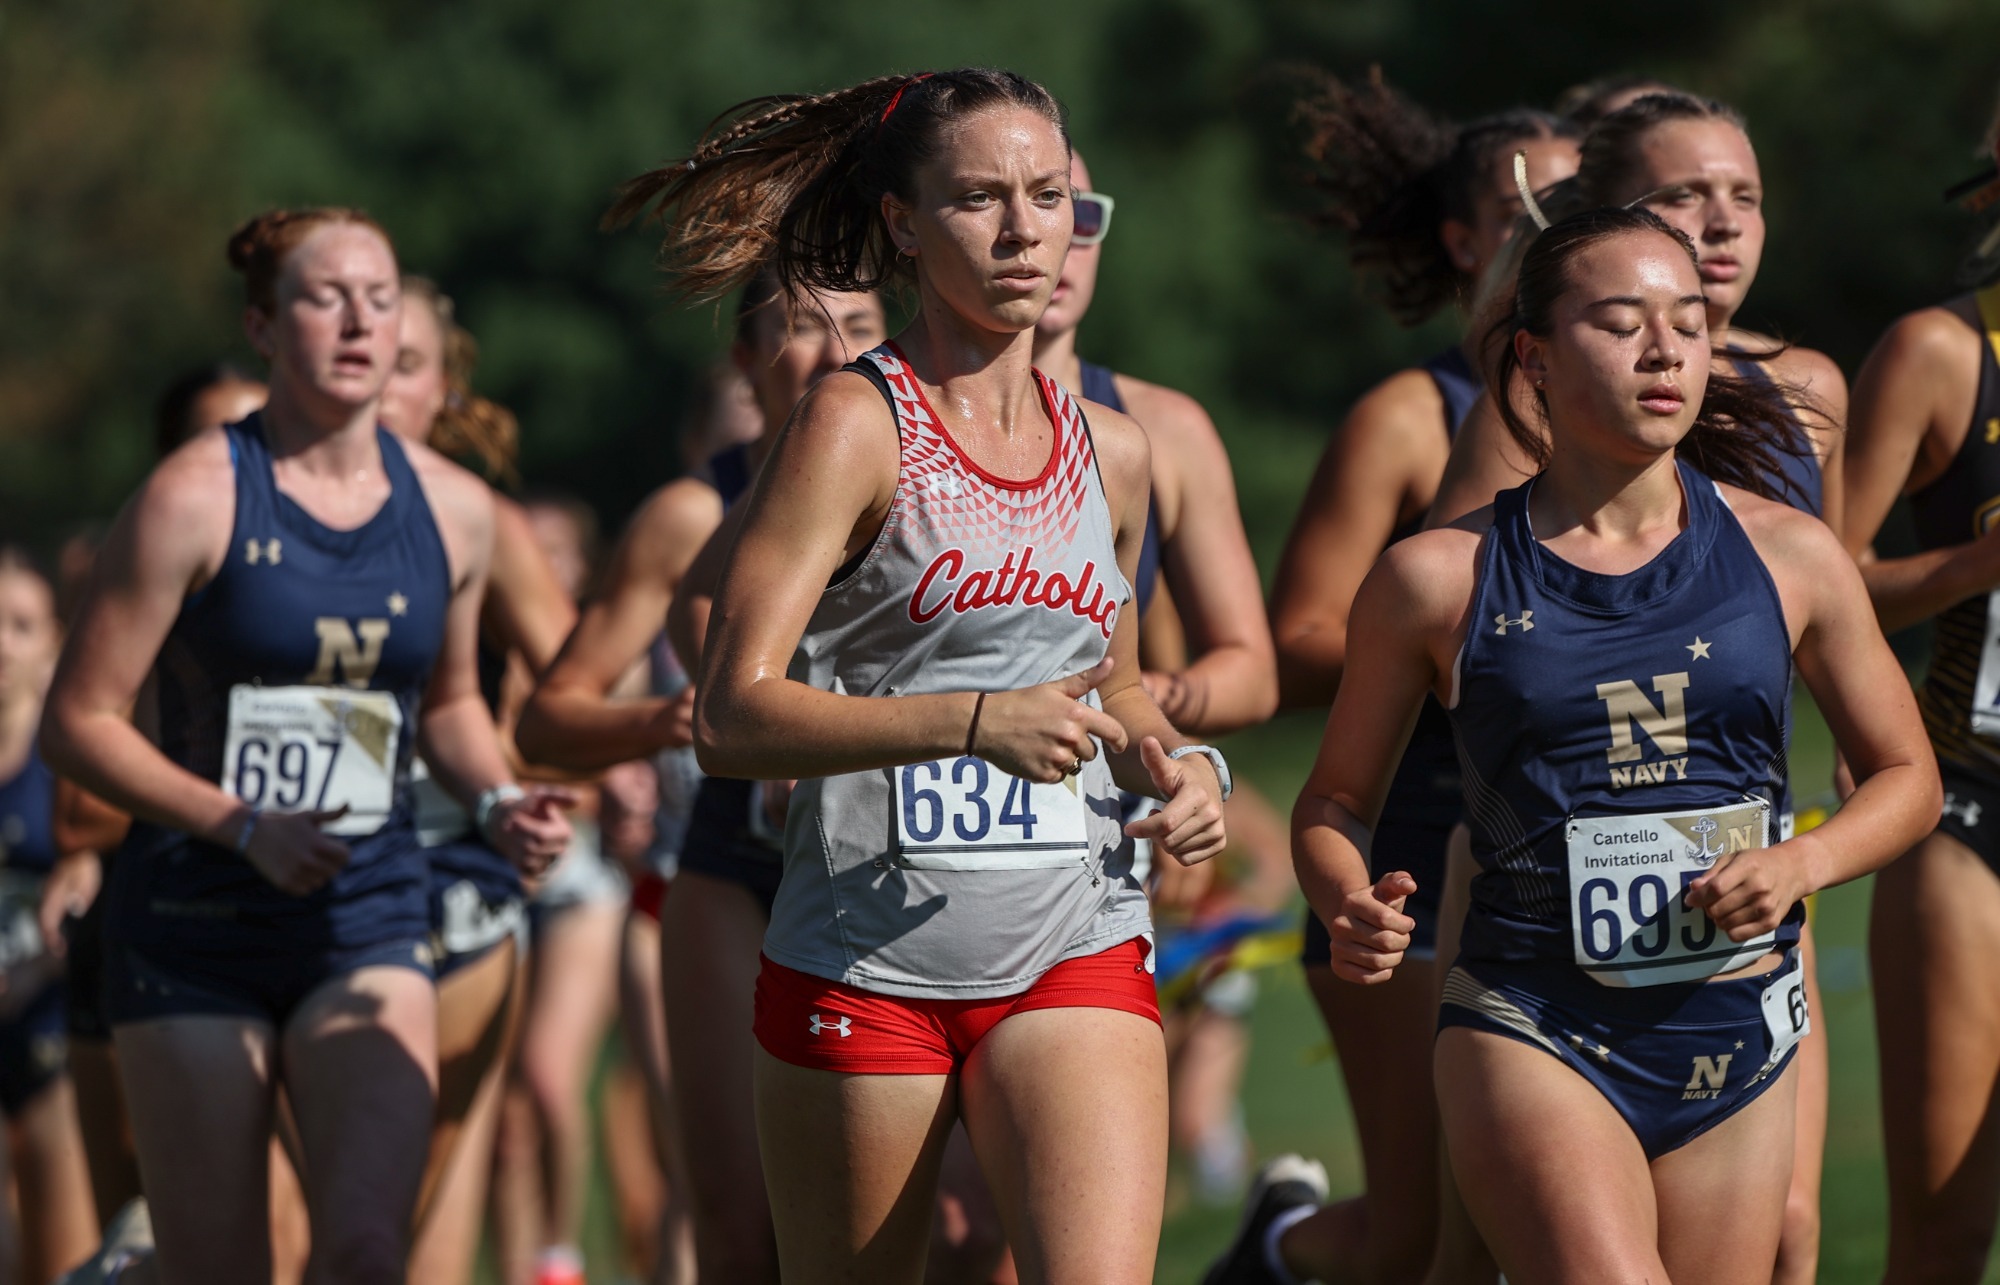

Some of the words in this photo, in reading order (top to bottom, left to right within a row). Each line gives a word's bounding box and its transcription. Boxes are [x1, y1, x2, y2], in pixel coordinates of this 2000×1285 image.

[908, 546, 1117, 640] Catholic
[304, 616, 390, 689] N
[1596, 671, 1690, 764] N
[236, 738, 342, 810] 697
[902, 756, 1037, 842] 634
[1609, 757, 1688, 789] NAVY
[1585, 850, 1674, 869] Invitational
[1593, 829, 1659, 846] Cantello
[1727, 825, 1753, 855] N
[1579, 869, 1716, 961] 695
[1681, 1089, 1722, 1100] NAVY
[1686, 1054, 1733, 1090] N
